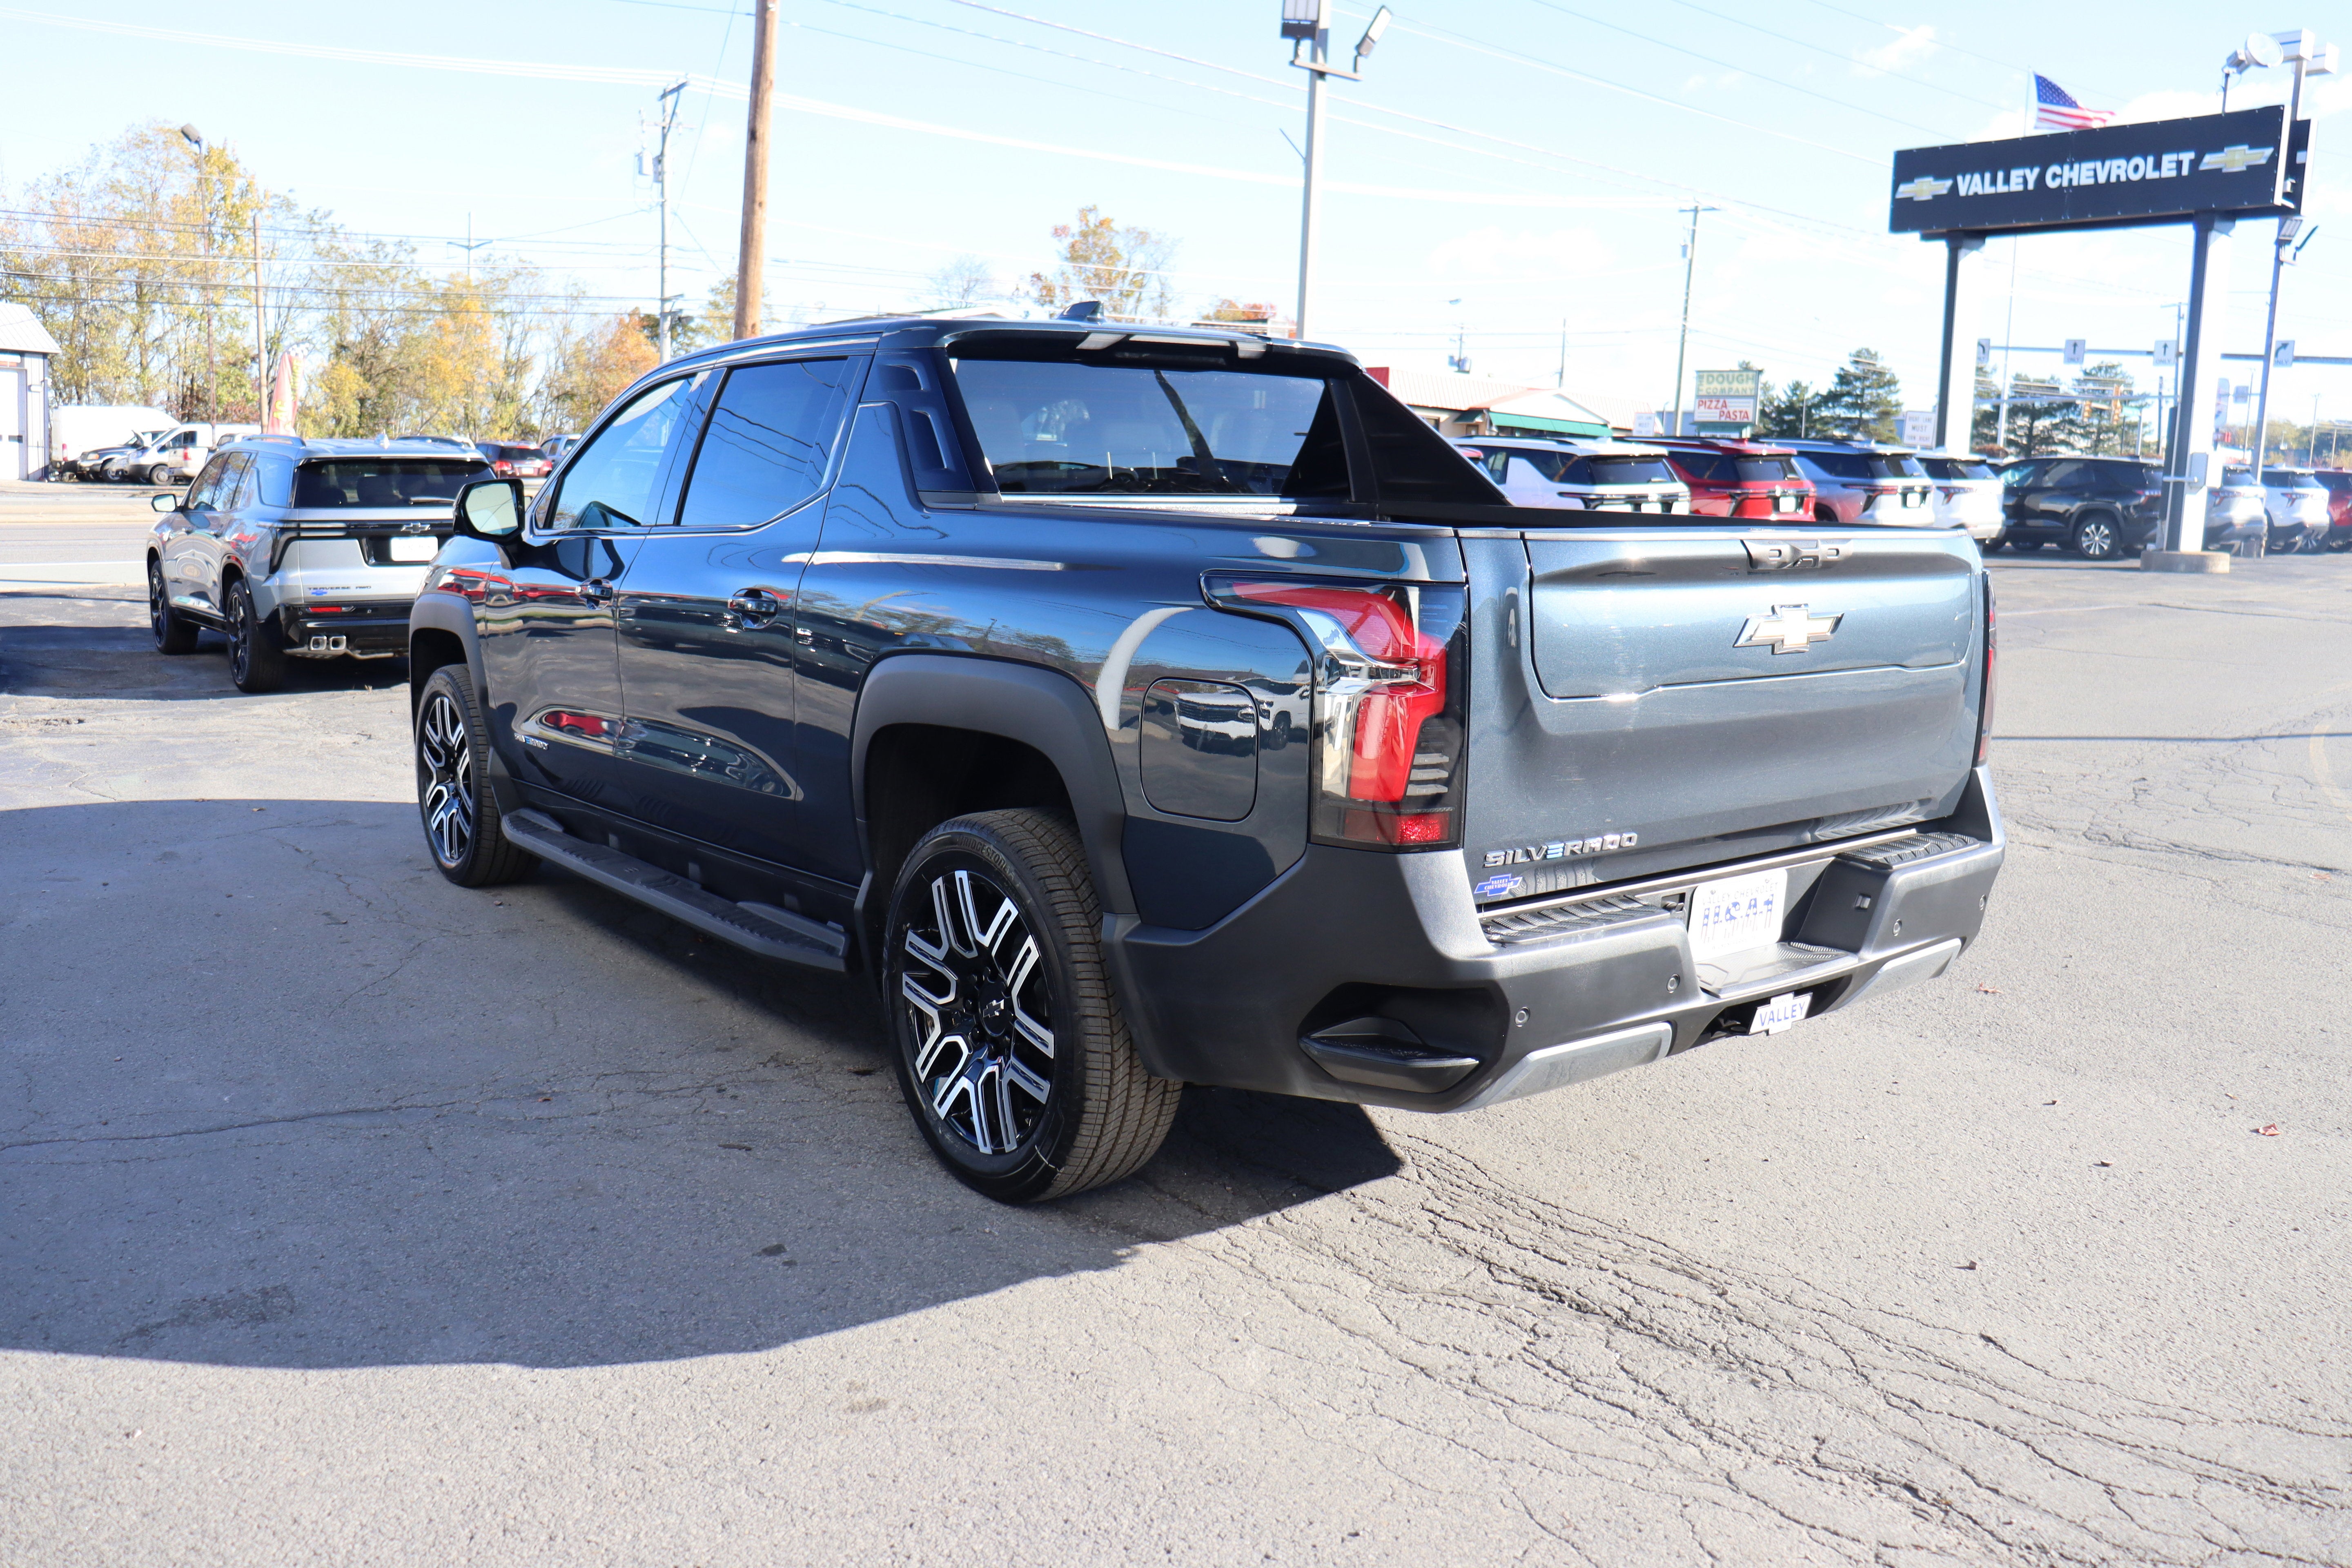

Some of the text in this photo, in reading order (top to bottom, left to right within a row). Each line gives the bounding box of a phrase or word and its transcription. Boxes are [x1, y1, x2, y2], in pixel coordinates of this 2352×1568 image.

[1957, 151, 2195, 196] VALLEY CHEVROLET
[1706, 374, 1755, 385] DOUGH
[1697, 399, 1727, 410] PIZZA
[1718, 410, 1749, 421] PASTA
[959, 835, 1010, 874] BRIDGESTONE
[1482, 832, 1637, 867] SILVERADO
[1702, 882, 1778, 906] VALLEY CHEVROLET
[1760, 1002, 1805, 1027] VALLEY
